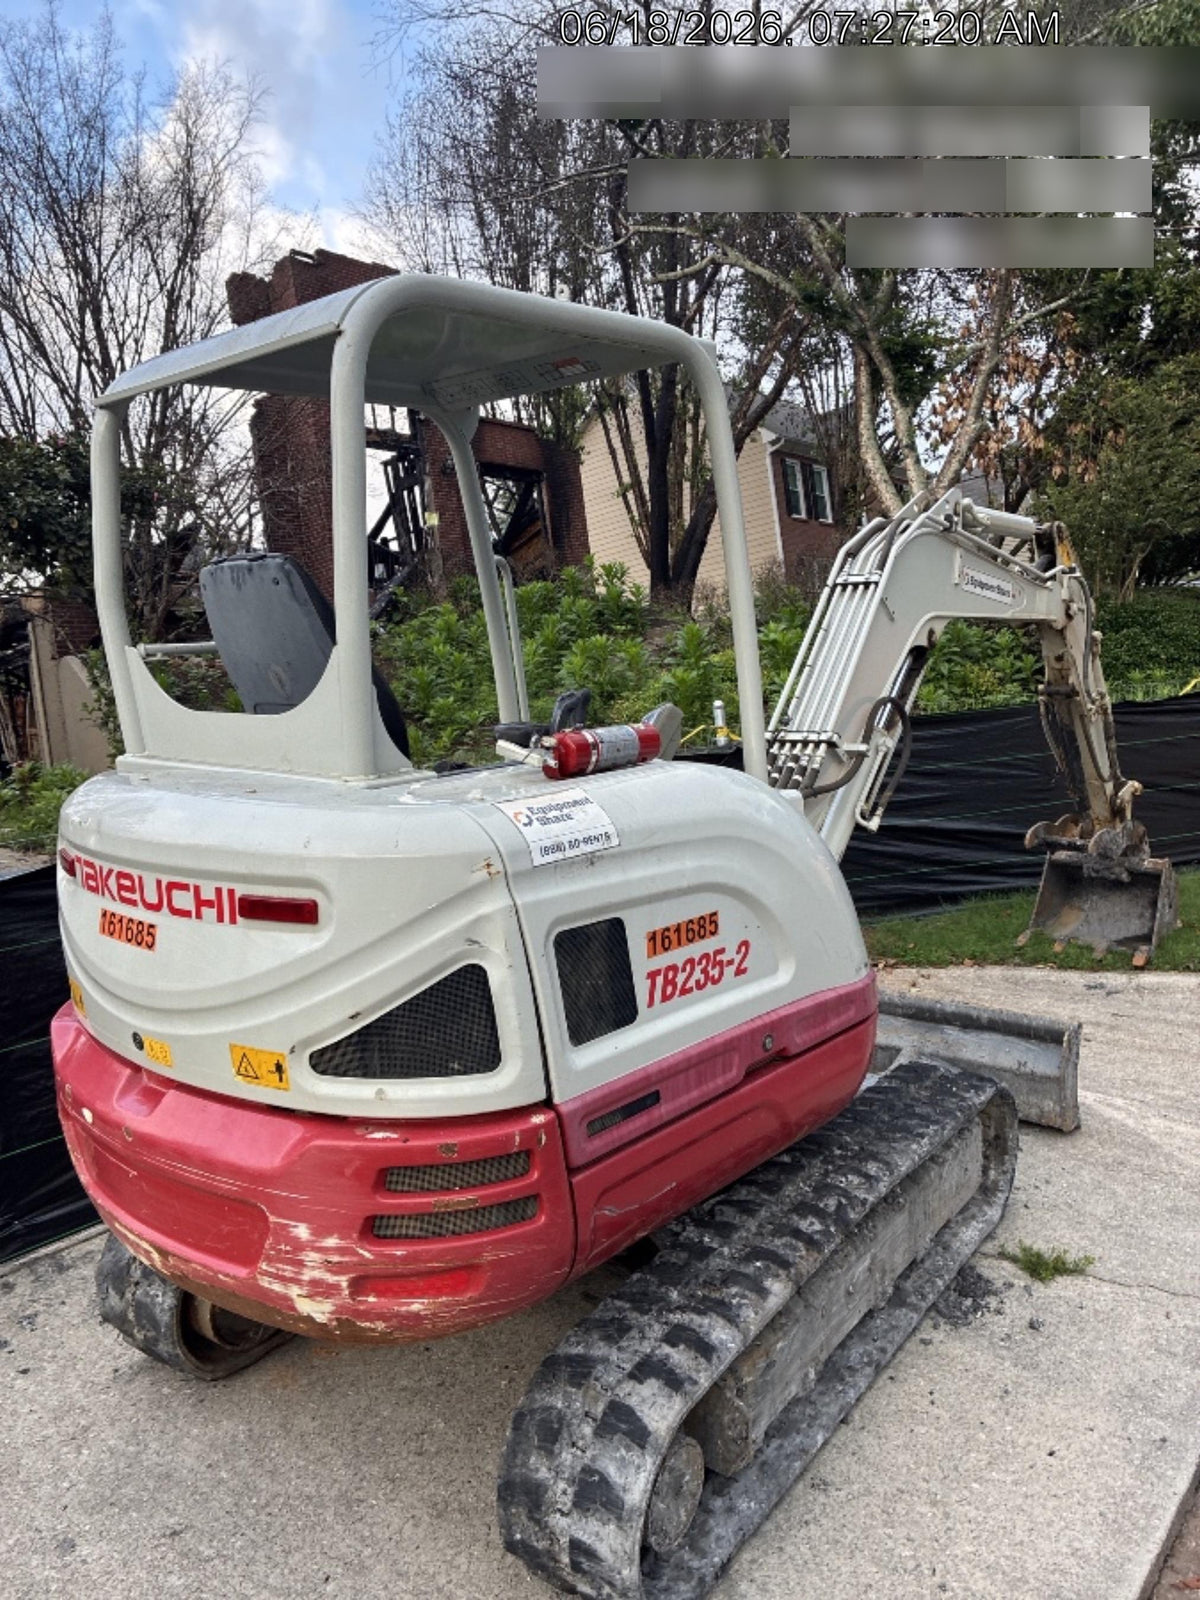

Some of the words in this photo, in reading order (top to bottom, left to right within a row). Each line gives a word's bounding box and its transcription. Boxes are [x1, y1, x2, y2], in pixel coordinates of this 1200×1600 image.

[527, 797, 594, 816] Equipment
[535, 811, 574, 827] Share
[100, 910, 156, 949] 161685
[648, 911, 719, 956] 161685
[645, 939, 751, 1009] TB235-2
